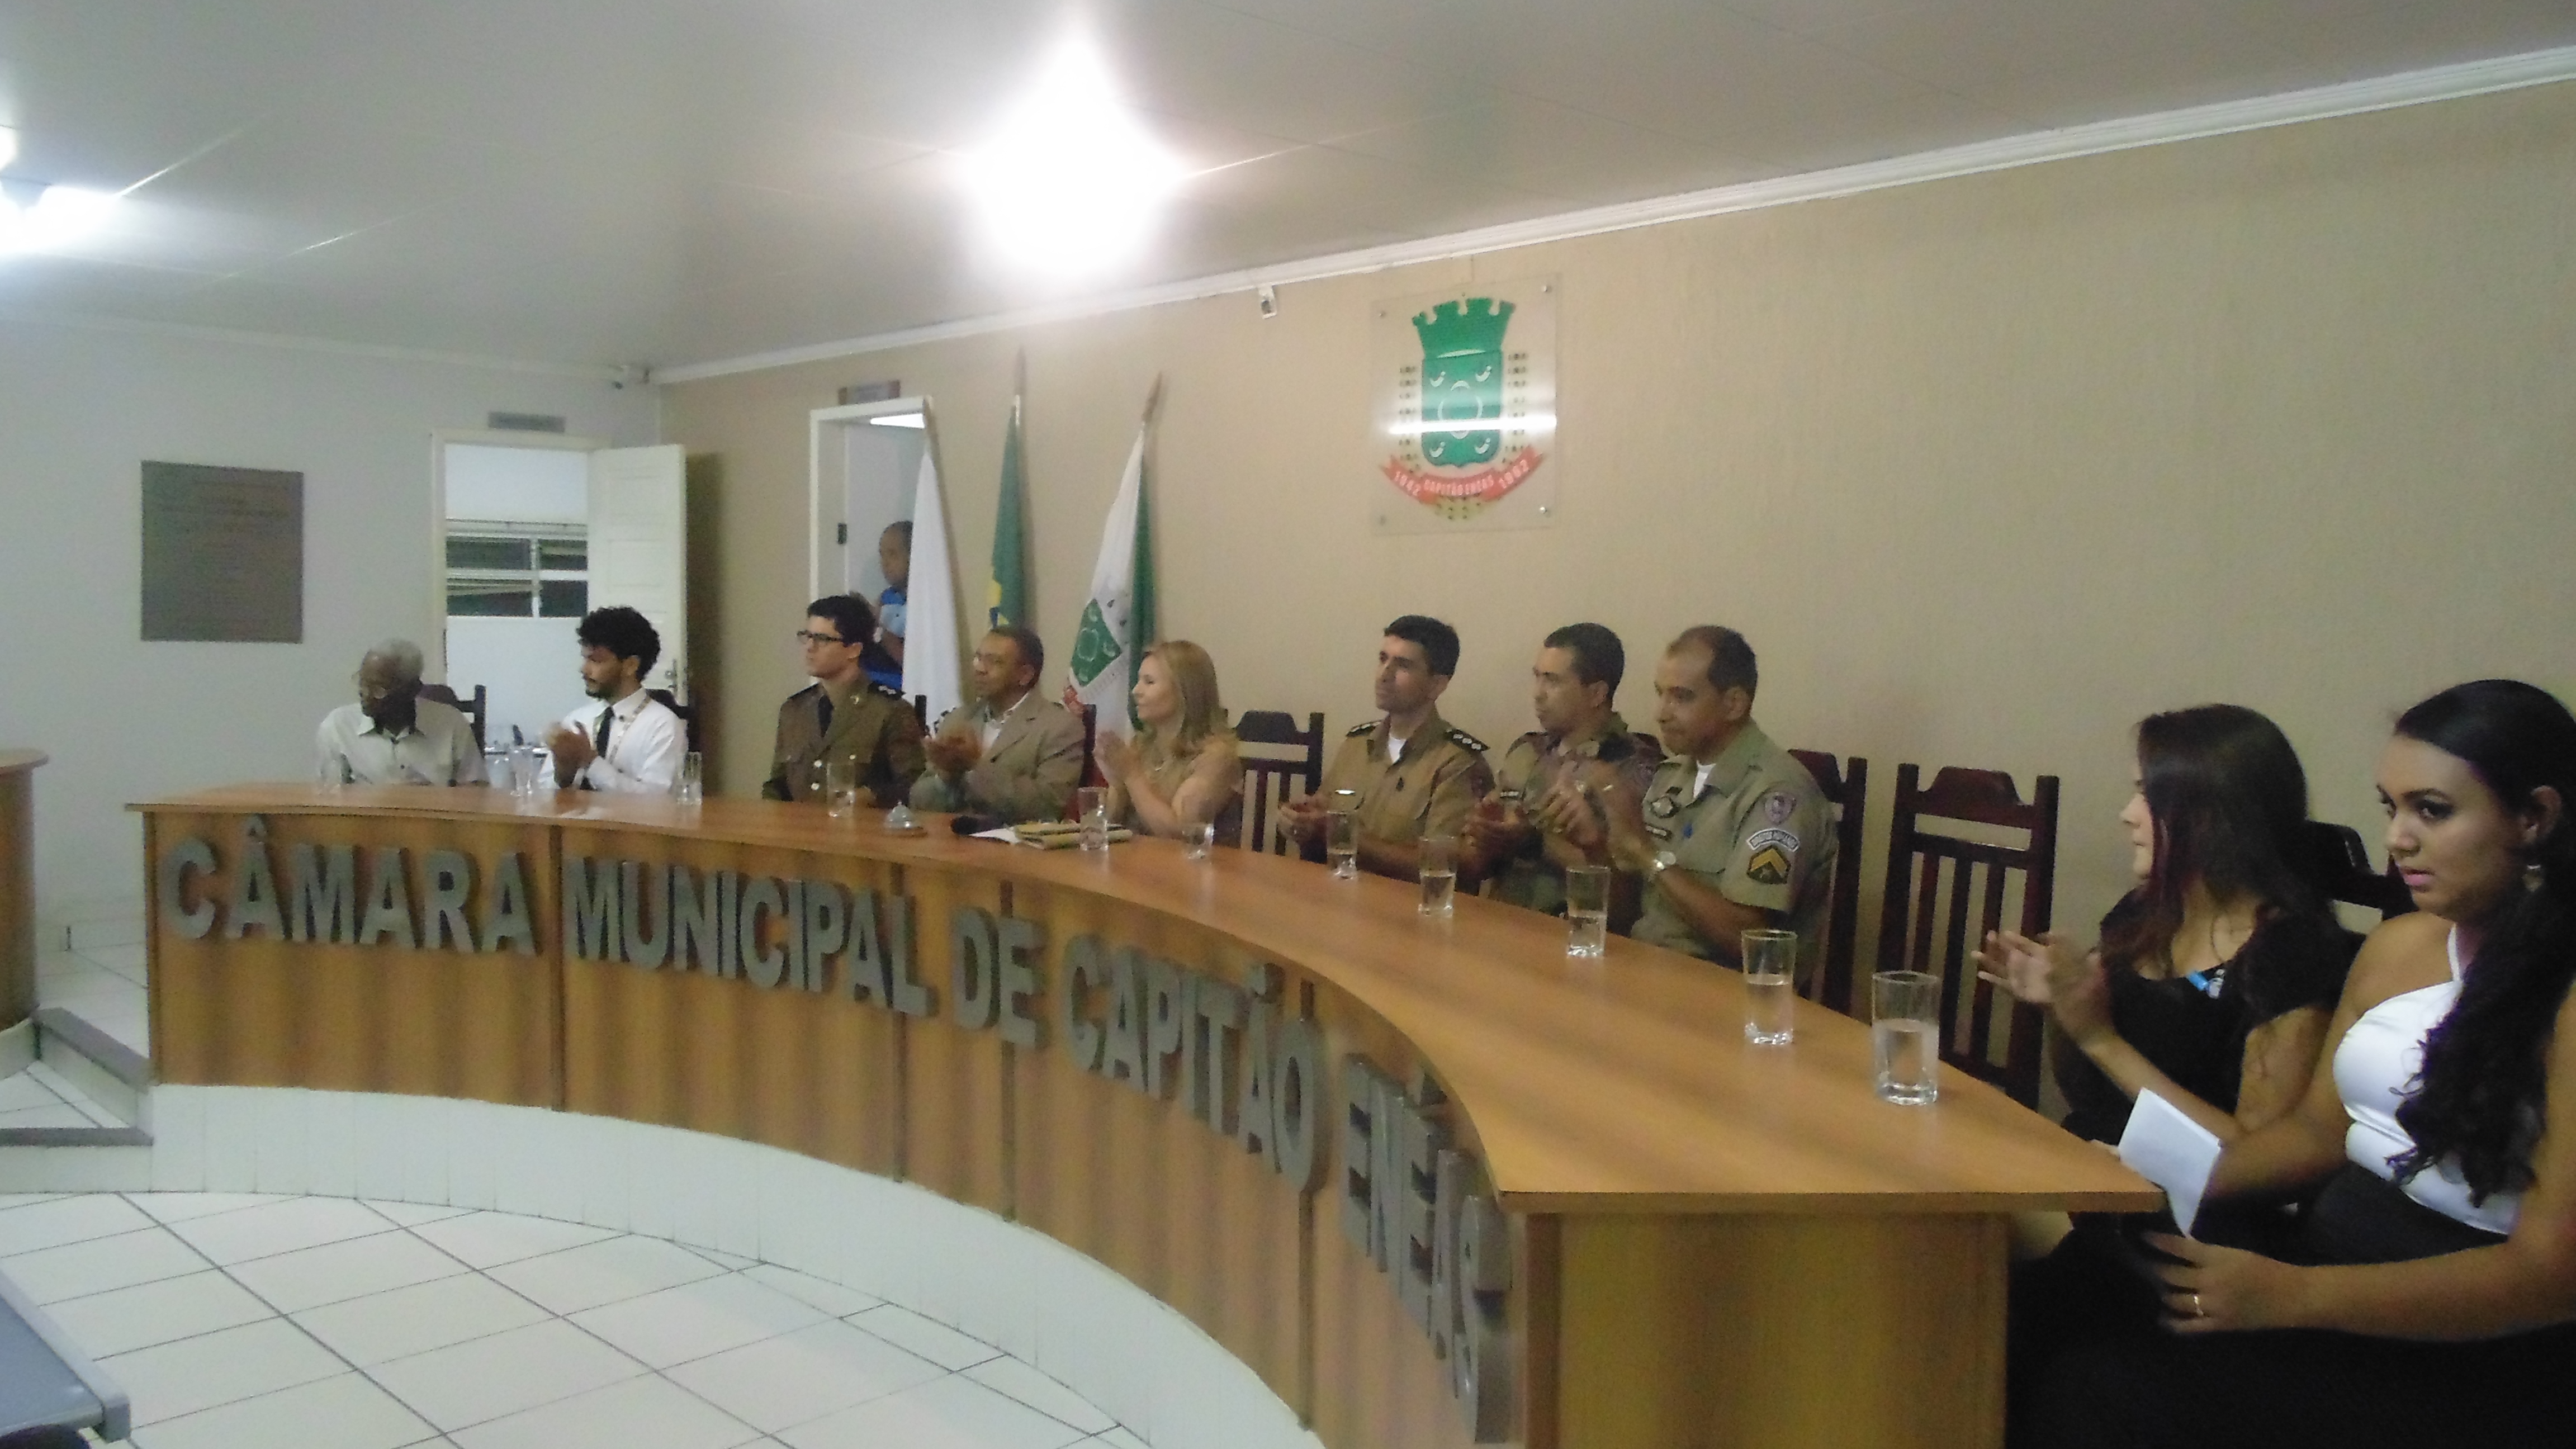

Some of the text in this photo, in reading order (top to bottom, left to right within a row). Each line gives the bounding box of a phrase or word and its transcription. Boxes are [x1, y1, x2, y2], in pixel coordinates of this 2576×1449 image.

[158, 812, 1509, 1442] CÂMARA MUNICIPAL DE CAPITÃO ENÉAS
